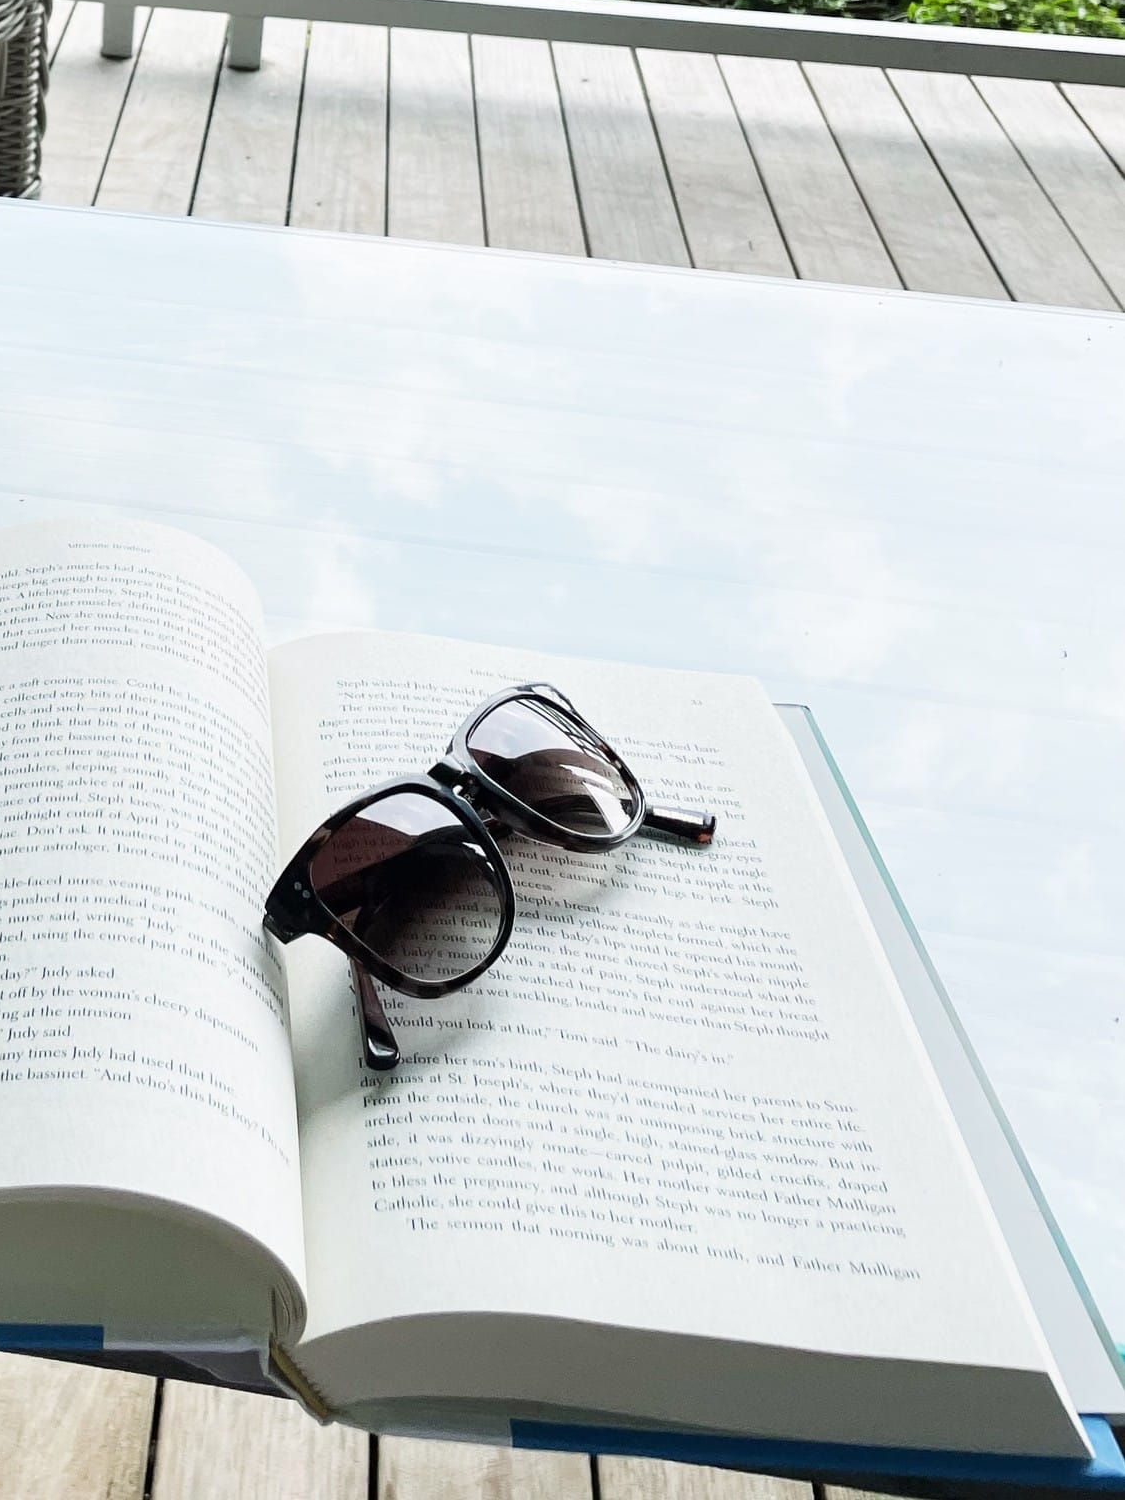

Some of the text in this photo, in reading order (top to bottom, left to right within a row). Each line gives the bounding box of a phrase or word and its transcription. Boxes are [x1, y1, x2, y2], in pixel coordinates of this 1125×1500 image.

[20, 678, 39, 686] soft
[3, 690, 57, 703] collected
[560, 870, 686, 898] causing his tiny legs
[544, 911, 673, 940] until yellow droplets
[40, 966, 71, 979] Judy
[7, 987, 28, 998] off
[30, 985, 47, 999] by
[51, 985, 74, 996] the
[143, 993, 188, 1013] cheery
[21, 1007, 35, 1017] at
[39, 1005, 62, 1016] the
[6, 1026, 38, 1041] Judy
[27, 1048, 67, 1058] times
[71, 1046, 101, 1060] Judy
[108, 1047, 136, 1062] had
[140, 1057, 173, 1070] used
[178, 1063, 204, 1080] that
[0, 1068, 23, 1081] the
[179, 1084, 204, 1100] this
[208, 1093, 228, 1111] big
[363, 1094, 401, 1108] From
[406, 1091, 429, 1103] the
[497, 1095, 520, 1107] the
[527, 1099, 578, 1114] church
[583, 1109, 609, 1119] was
[639, 1117, 725, 1139] unimposing
[727, 1126, 766, 1141] brick
[771, 1134, 835, 1147] structure
[840, 1140, 873, 1152] with
[427, 1153, 470, 1164] votive
[541, 1159, 563, 1172] the
[622, 1170, 650, 1185] Her
[657, 1178, 709, 1193] mother
[715, 1188, 768, 1201] wanted
[773, 1191, 820, 1206] Father
[825, 1196, 896, 1215] Mulligan
[371, 1179, 386, 1189] to
[390, 1174, 427, 1187] bless
[432, 1172, 456, 1185] the
[549, 1183, 577, 1195] and
[583, 1185, 649, 1207] although
[654, 1195, 698, 1214] Steph
[704, 1206, 731, 1217] was
[760, 1209, 809, 1228] longer
[829, 1221, 906, 1237] practicing
[405, 1216, 438, 1229] The
[446, 1221, 503, 1230] sermon
[511, 1219, 540, 1233] that
[548, 1227, 615, 1246] morning
[621, 1237, 648, 1246] was
[656, 1237, 699, 1254] about
[756, 1254, 785, 1266] and
[791, 1255, 840, 1271] Father
[848, 1261, 921, 1279] Mulligan
